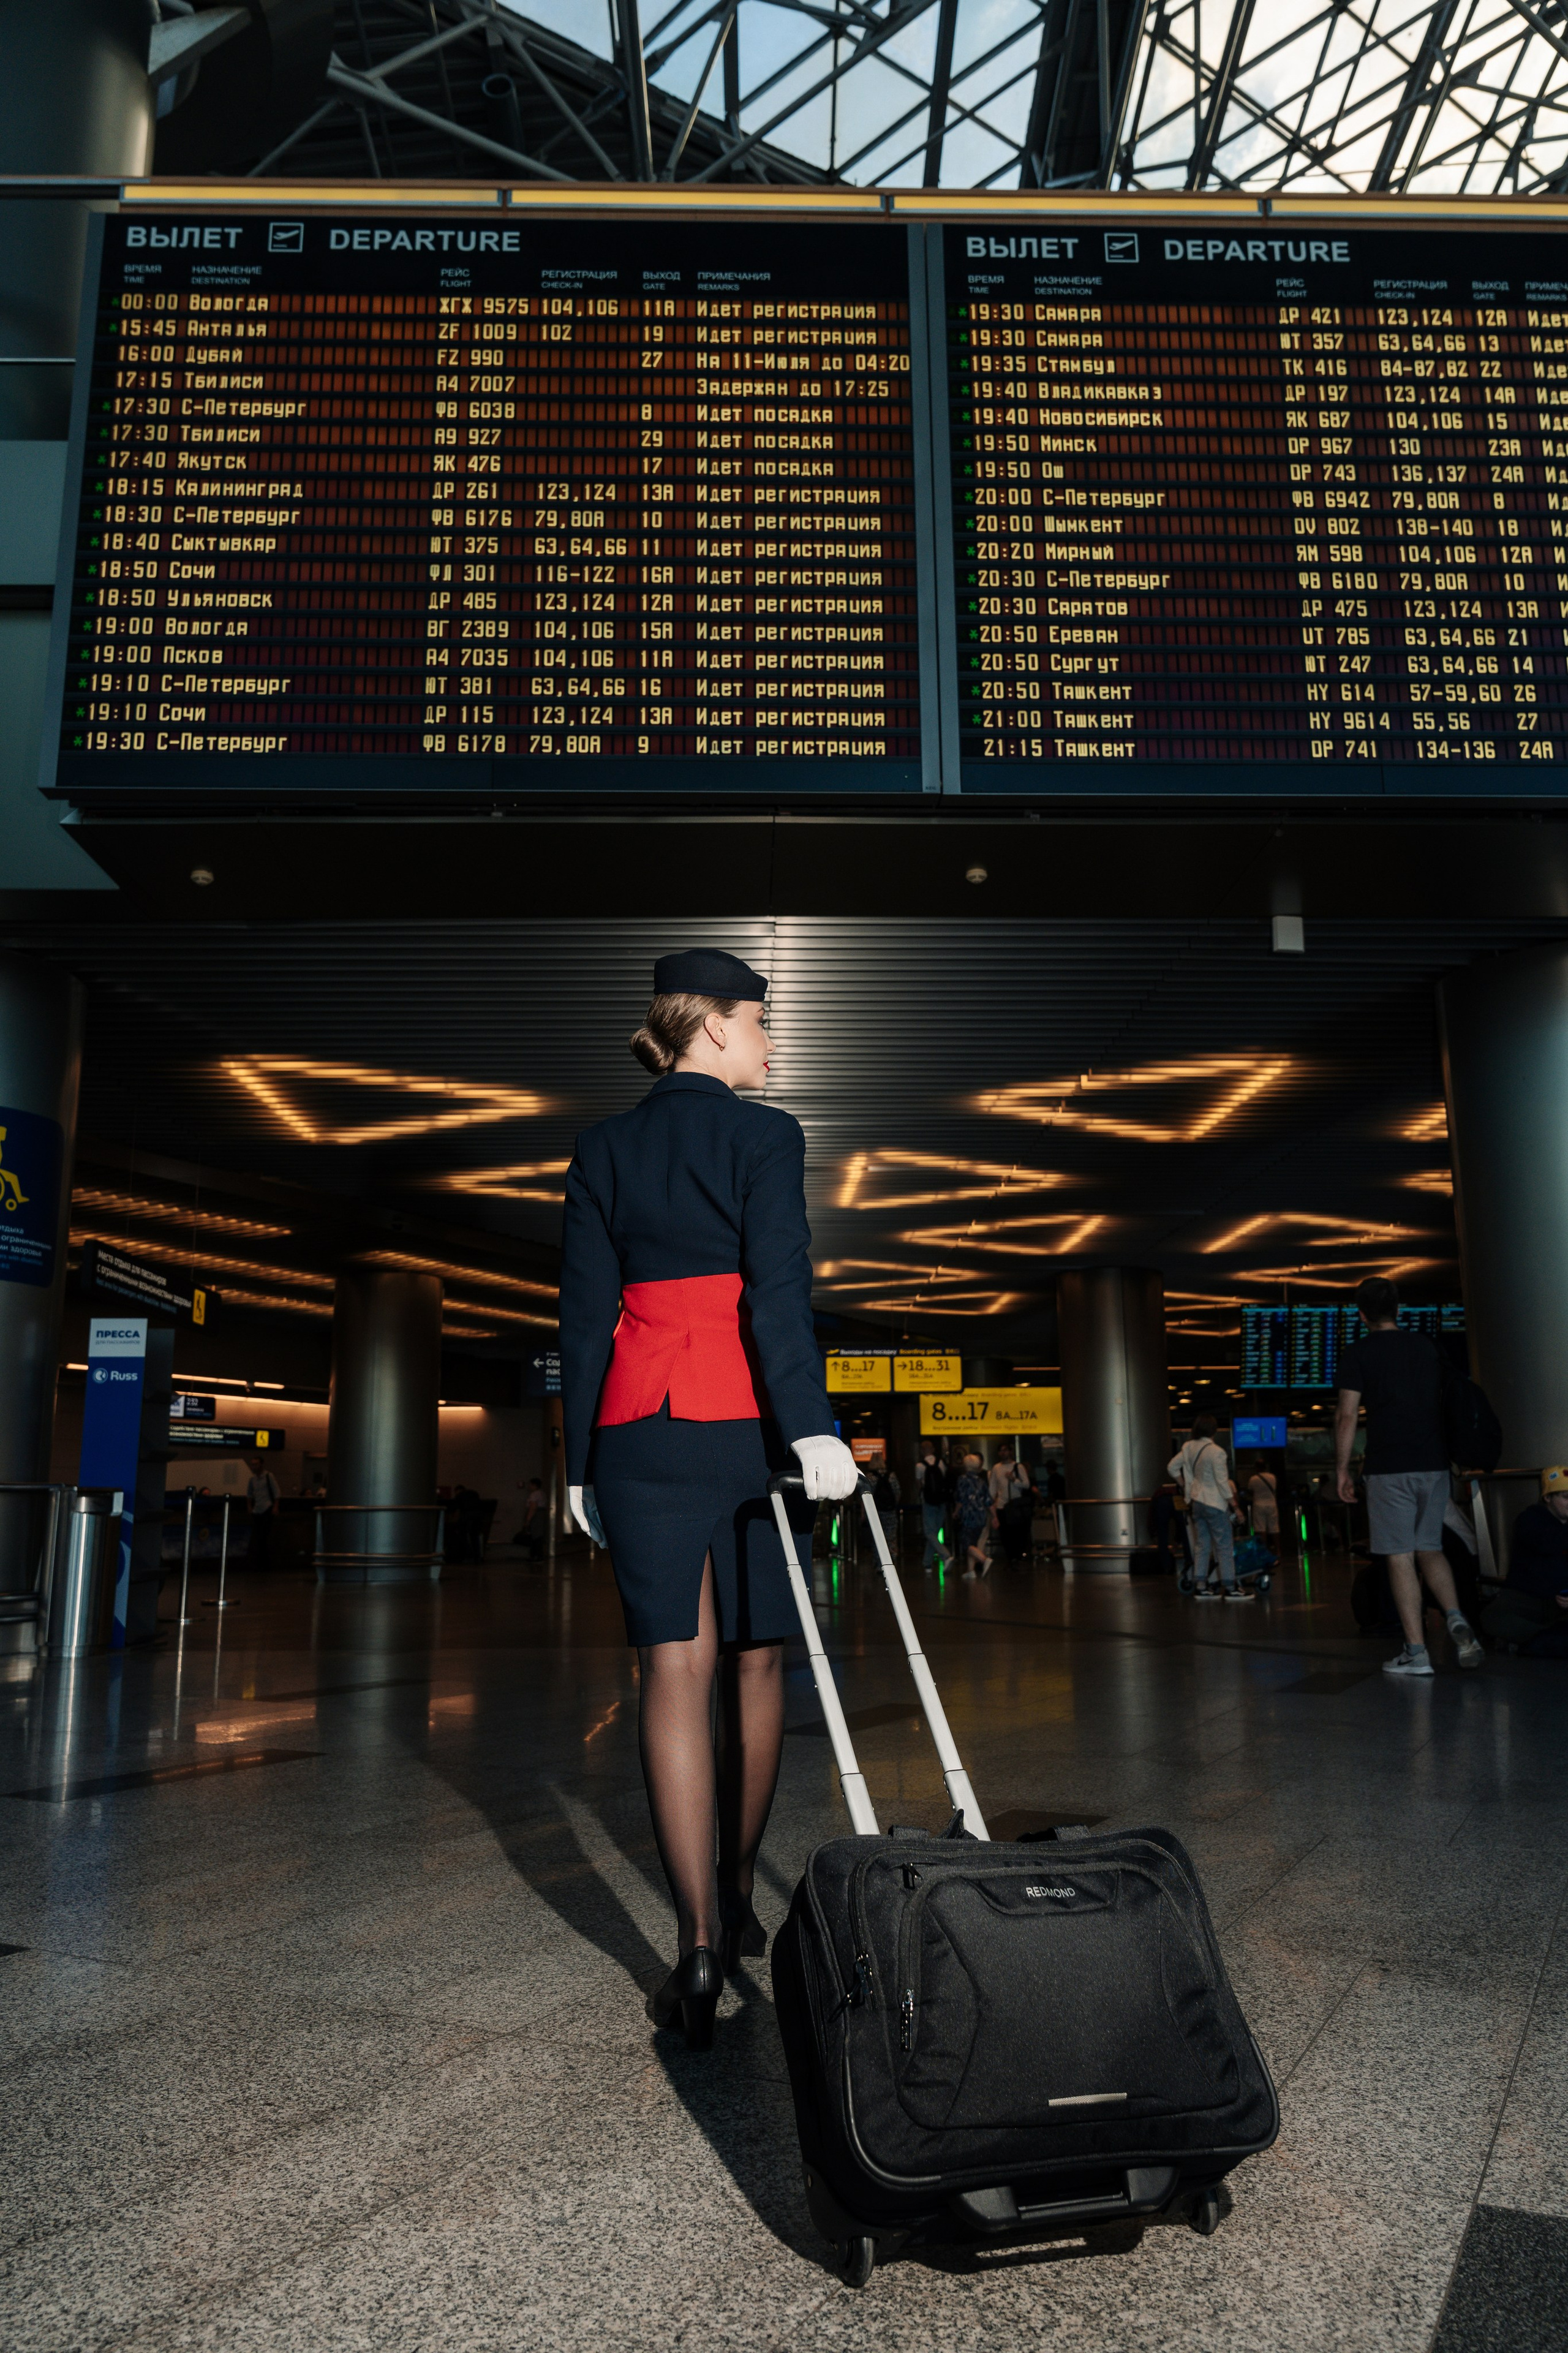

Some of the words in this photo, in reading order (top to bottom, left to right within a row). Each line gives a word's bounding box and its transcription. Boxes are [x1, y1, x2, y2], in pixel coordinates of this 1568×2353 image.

[127, 229, 243, 248] ВЫЛЕТ
[330, 230, 520, 251] DEPARTURE
[967, 237, 1079, 259] ВЫЛЕТ
[1164, 240, 1350, 262] DEPARTURE
[124, 264, 161, 273] ВРЕМЯ
[192, 265, 262, 274] НАЗНАЧЕНИЕ
[441, 267, 470, 277] РЕЙС
[542, 270, 617, 280] РЕГИСТРАЦИЯ
[643, 271, 680, 281] ВЫХОД
[698, 272, 771, 281] ПРИМЕЧАНИЯ
[1035, 276, 1102, 285] НАЗНАЧЕНИЕ
[1276, 278, 1305, 287] РЕЙС
[1374, 280, 1447, 290] РЕГИСТРАЦИЯ
[1472, 281, 1509, 290] ВЫХОД
[1525, 282, 1568, 291] ПРИМЕЧ
[122, 294, 178, 310] 00:00
[189, 294, 268, 311] Вологда
[484, 298, 529, 314] 9575
[543, 299, 618, 317] 104,106
[697, 301, 742, 317] Идет
[753, 304, 876, 320] регистрация
[970, 304, 1024, 320] 19:30
[1035, 304, 1101, 323] Самара
[1311, 308, 1340, 324] 421
[1378, 308, 1453, 327] 123,124
[122, 319, 176, 336] 15:45
[187, 320, 266, 337] Анталья
[439, 323, 459, 339] ZF
[474, 323, 517, 340] 1009
[542, 325, 571, 341] 102
[644, 326, 663, 342] 19
[697, 327, 742, 343] Идет
[753, 330, 876, 346] регистрация
[120, 346, 174, 362] 16:00
[186, 346, 243, 364] Дубай
[437, 349, 459, 365] FZ
[470, 349, 503, 366] 990
[641, 351, 663, 368] 27
[696, 352, 720, 369] На
[733, 352, 810, 369] 11-Июля
[821, 357, 843, 371] до
[855, 354, 910, 371] 04:20
[972, 355, 1026, 372] 19:35
[1037, 356, 1115, 375] Стамбул
[1315, 359, 1347, 376] 416
[1480, 361, 1502, 378] 22
[1533, 361, 1568, 379] Иде
[115, 398, 170, 415] 17:30
[181, 398, 306, 418] С-Петербург
[469, 402, 515, 418] 6038
[641, 404, 652, 420] 8
[697, 404, 742, 422] Идет
[754, 408, 833, 423] посадка
[111, 451, 166, 468] 17:40
[178, 451, 246, 471] Якутск
[433, 455, 456, 472] ЯК
[467, 455, 501, 472] 476
[643, 457, 663, 474] 17
[696, 458, 742, 475] Идет
[754, 462, 834, 477] посадка
[975, 488, 1031, 505] 20:00
[1042, 488, 1165, 508] С-Петербург
[1325, 491, 1371, 508] 6942
[1493, 492, 1505, 510] 8
[104, 533, 160, 550] 18:40
[172, 533, 276, 554] Сыктывкар
[430, 537, 452, 553] ЮТ
[464, 537, 498, 554] 375
[535, 537, 627, 557] 63,64,66
[643, 538, 659, 556] 11
[696, 539, 743, 557] Идет
[755, 543, 881, 559] регистрация
[981, 653, 1039, 671] 20:50
[1050, 654, 1119, 674] Сургут
[1305, 655, 1326, 673] ЮТ
[1338, 655, 1371, 673] 247
[1408, 655, 1499, 676] 63,64,66
[1512, 656, 1534, 674] 14
[92, 674, 149, 692] 19:10
[161, 674, 291, 695] С-Петербург
[425, 677, 447, 694] ЮТ
[460, 677, 491, 695] 381
[531, 678, 625, 698] 63,64,66
[641, 678, 661, 696] 16
[696, 679, 743, 697] Идет
[755, 683, 884, 700] регистрация
[983, 710, 1041, 728] 21:00
[1053, 710, 1134, 728] Ташкент
[1343, 712, 1390, 730] 9614
[1412, 712, 1471, 732] 55,56
[1517, 712, 1538, 730] 27
[87, 731, 145, 750] 19:30
[157, 732, 287, 753] С-Петербург
[458, 735, 505, 753] 6178
[638, 736, 649, 753] 9
[696, 736, 744, 755] Идет
[756, 740, 886, 757] регистрация
[110, 1370, 138, 1381] Russ
[1025, 1886, 1076, 1898] REDMOND
